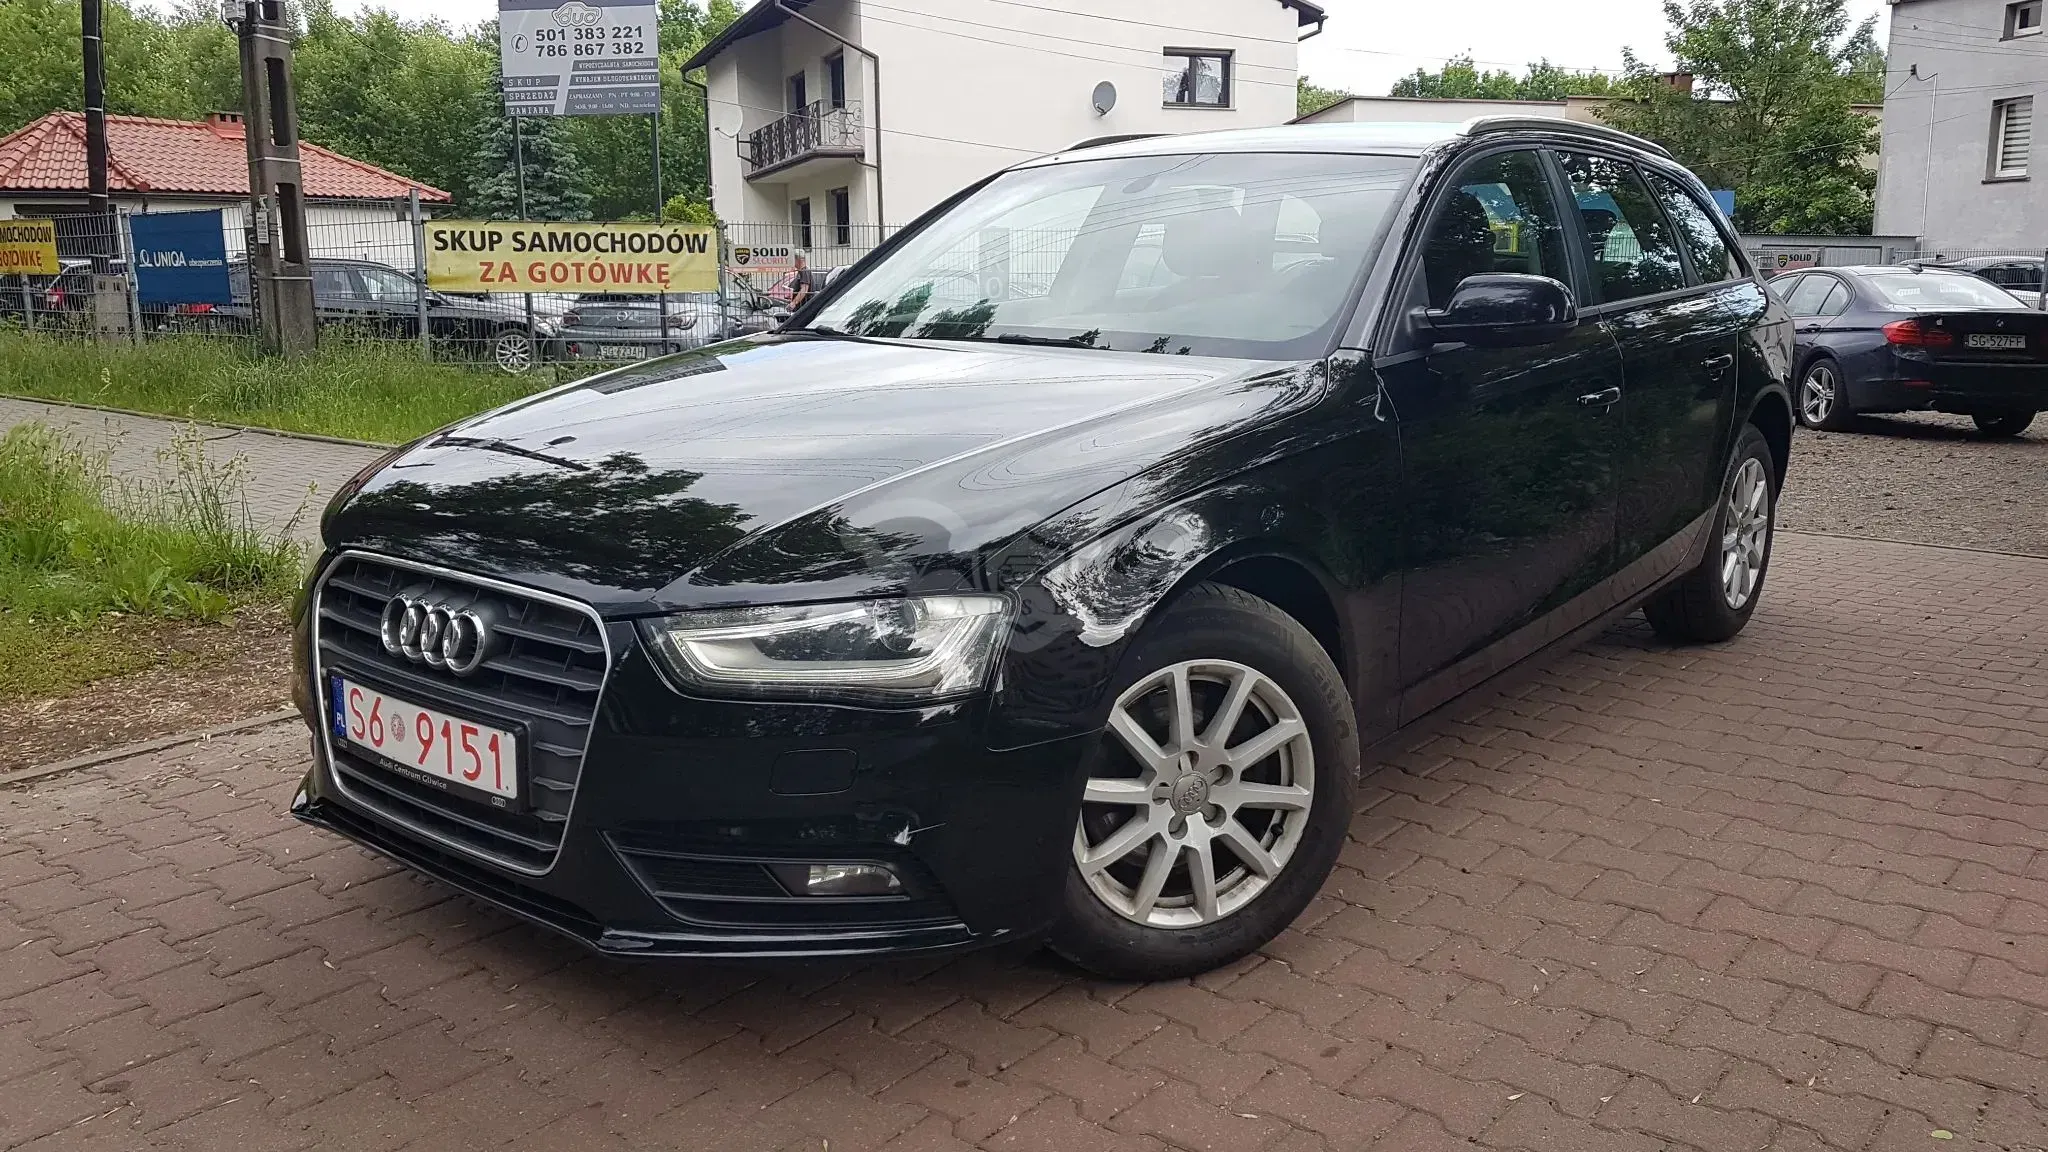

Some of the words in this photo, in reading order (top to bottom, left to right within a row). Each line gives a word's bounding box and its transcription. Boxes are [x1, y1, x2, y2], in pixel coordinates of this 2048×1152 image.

[535, 28, 567, 42] 501
[574, 27, 606, 41] 383
[612, 25, 644, 39] 221
[536, 44, 568, 58] 786
[573, 43, 605, 57] 867
[612, 41, 644, 55] 382
[508, 78, 541, 87] SKUP
[510, 107, 550, 115] ZAMIANA
[433, 229, 503, 252] SKUP
[511, 227, 708, 255] SAMOCHODÓW
[153, 251, 187, 268] UNIQA
[752, 247, 789, 257] SOLID
[1789, 253, 1812, 262] SOLID
[752, 257, 789, 265] SECURITY
[479, 261, 518, 283] ZA
[527, 256, 672, 289] GOTÓWKĘ
[1971, 334, 1986, 347] SG
[1989, 335, 2023, 348] 527FF
[335, 711, 347, 729] PL
[349, 687, 385, 748] S6
[416, 711, 503, 791] 9151
[379, 758, 393, 770] Audi
[394, 763, 421, 782] Centrum
